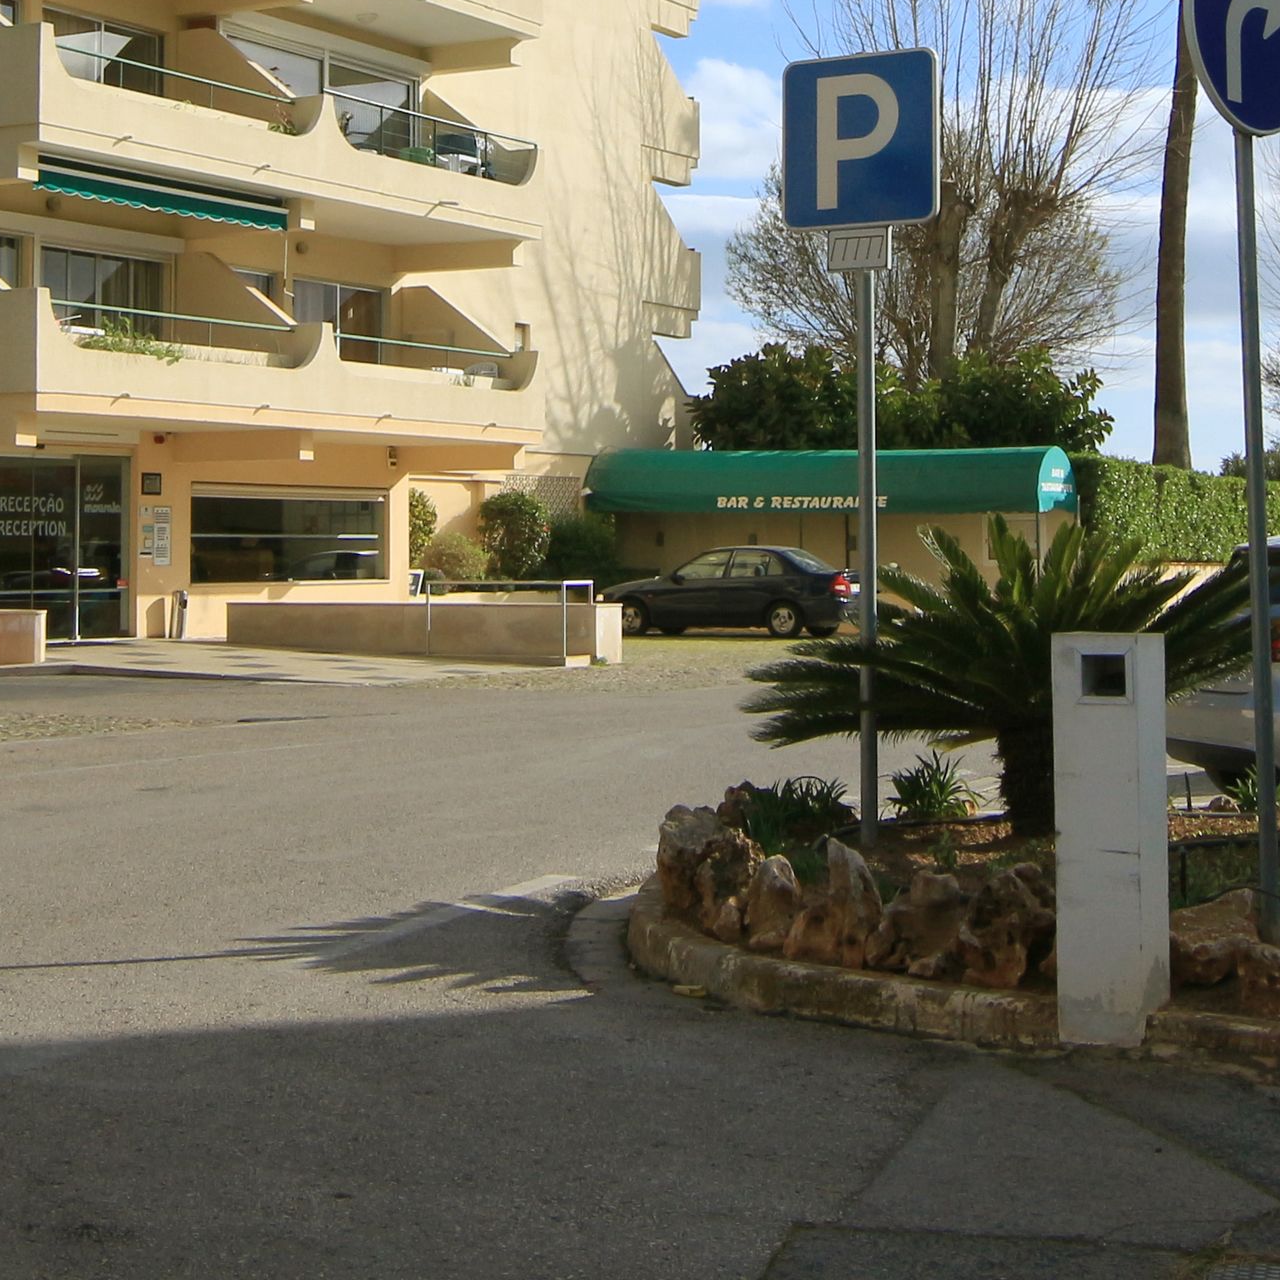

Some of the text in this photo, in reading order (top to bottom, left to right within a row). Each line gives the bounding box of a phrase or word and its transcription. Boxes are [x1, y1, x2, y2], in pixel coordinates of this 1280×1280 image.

[816, 73, 900, 210] P
[0, 492, 65, 516] RECEPÇÃO
[716, 496, 888, 509] BAR & RESTAURAE
